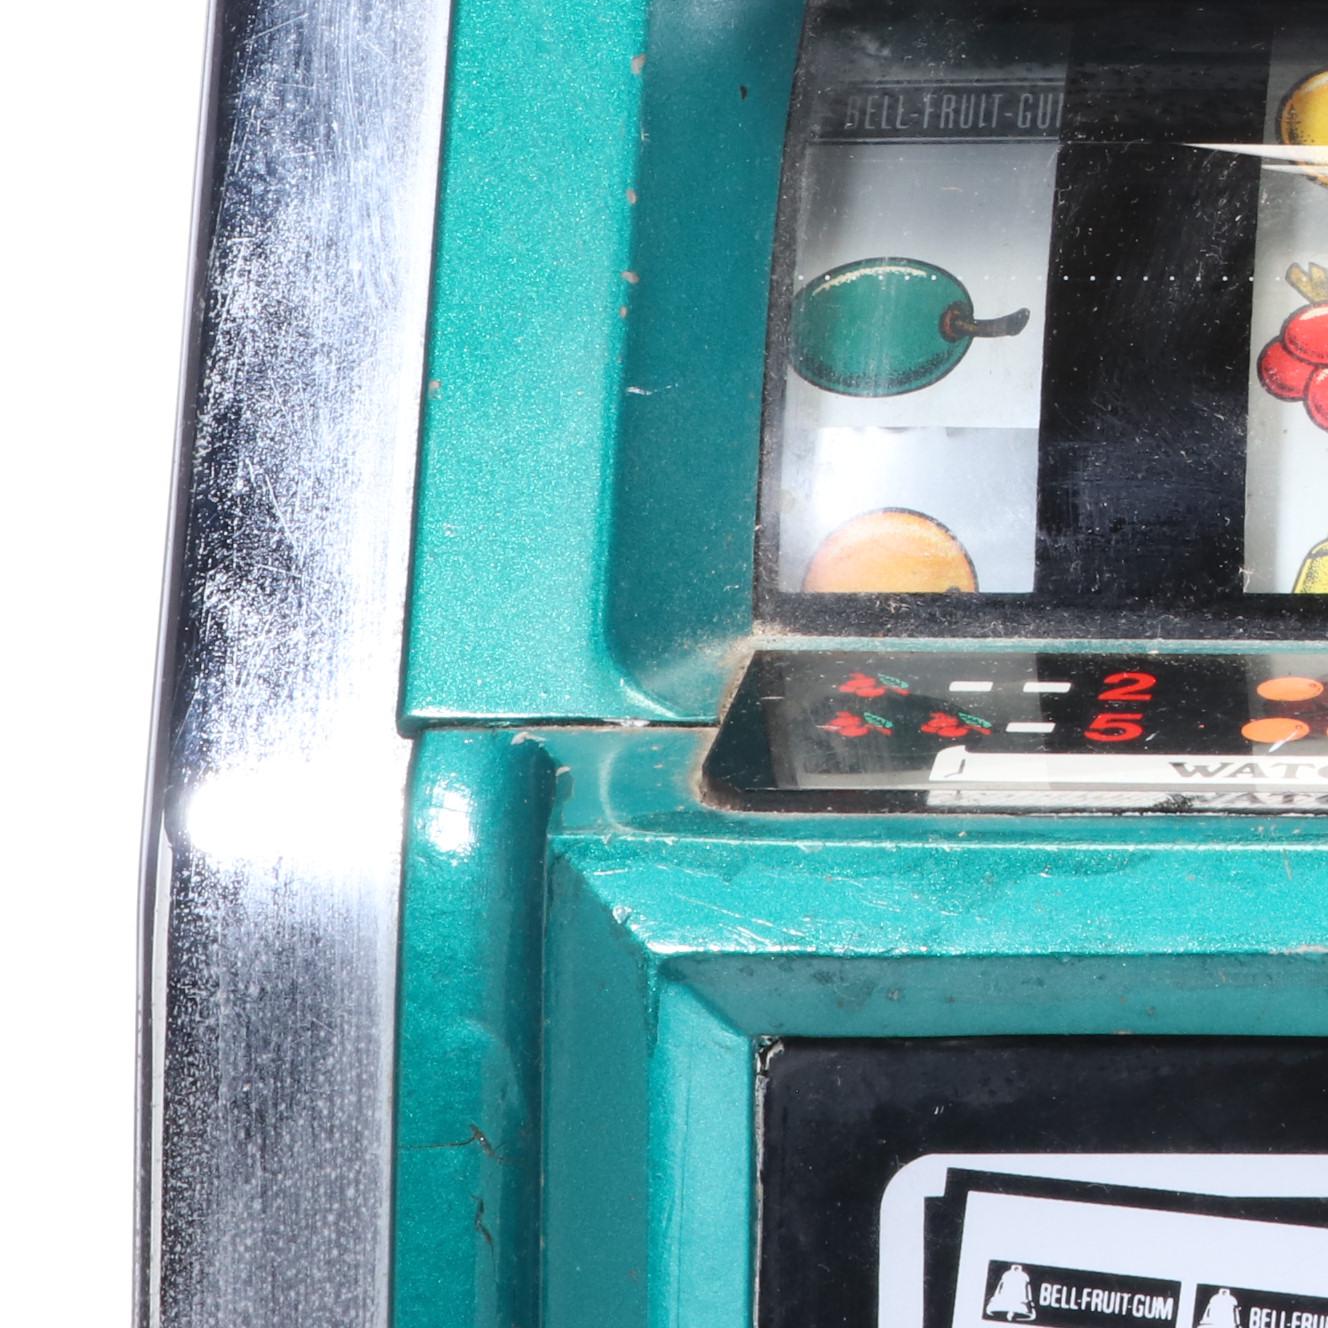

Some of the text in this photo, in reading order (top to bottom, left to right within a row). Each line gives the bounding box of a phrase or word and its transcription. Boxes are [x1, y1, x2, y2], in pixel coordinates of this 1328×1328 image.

[1097, 671, 1157, 701] 2
[1083, 712, 1144, 743] 5
[1039, 1282, 1175, 1321] BELL-FRUIT-GUM
